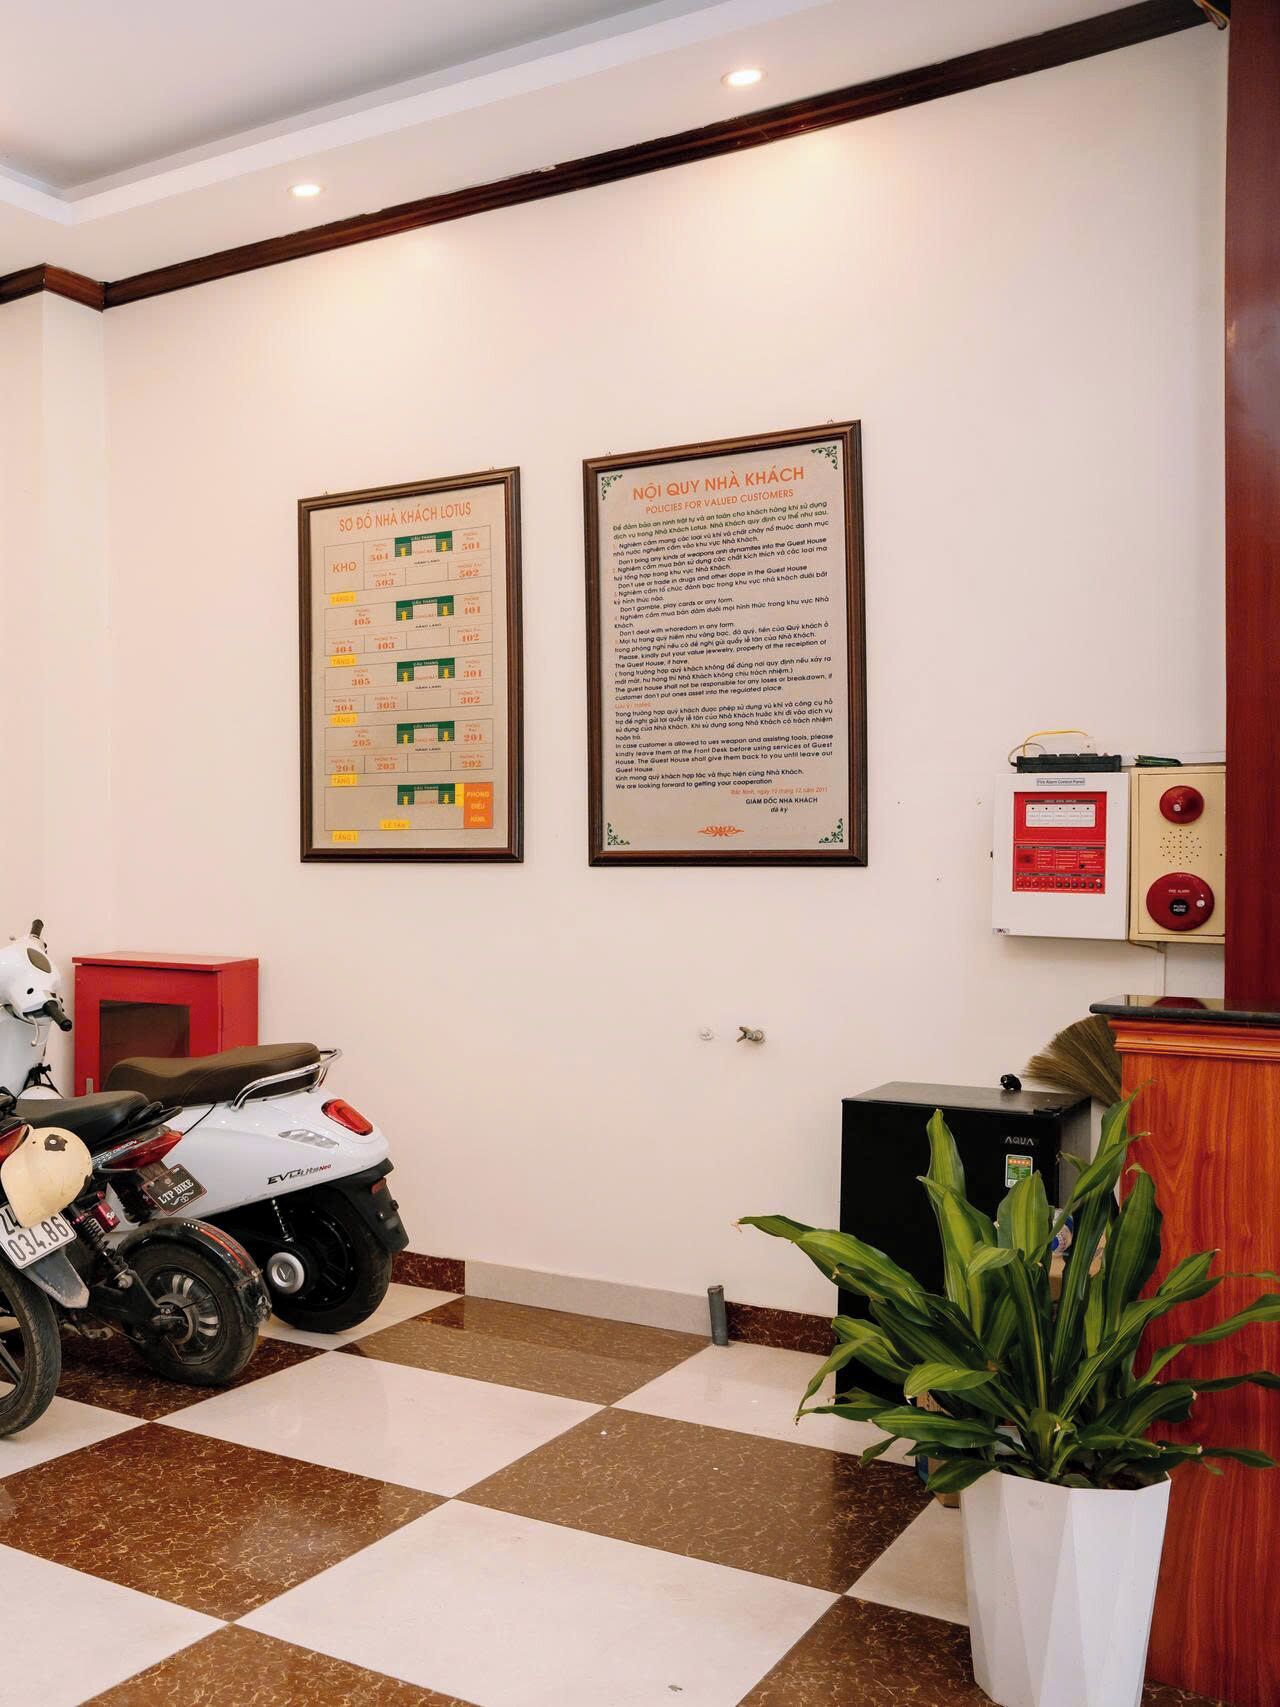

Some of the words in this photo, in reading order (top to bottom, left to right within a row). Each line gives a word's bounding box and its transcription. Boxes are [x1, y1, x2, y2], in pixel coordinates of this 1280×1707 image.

[633, 481, 661, 503] NỘI
[666, 479, 699, 497] QUY
[705, 470, 740, 490] NHÀ
[745, 461, 804, 486] KHÁCH
[646, 502, 681, 514] POLICIES
[684, 499, 700, 509] FOR
[704, 495, 737, 506] VALUED
[740, 488, 793, 502] CUSTOMERS
[339, 517, 352, 532] SƠ
[375, 509, 397, 527] NHÀ
[400, 501, 437, 524] KHÁCH
[440, 501, 471, 518] LOTUS
[332, 561, 356, 573] KHO
[1005, 1136, 1034, 1146] AQUA
[158, 1190, 176, 1204] LTP
[174, 1178, 194, 1194] BIKE
[7, 1216, 69, 1261] 034.86
